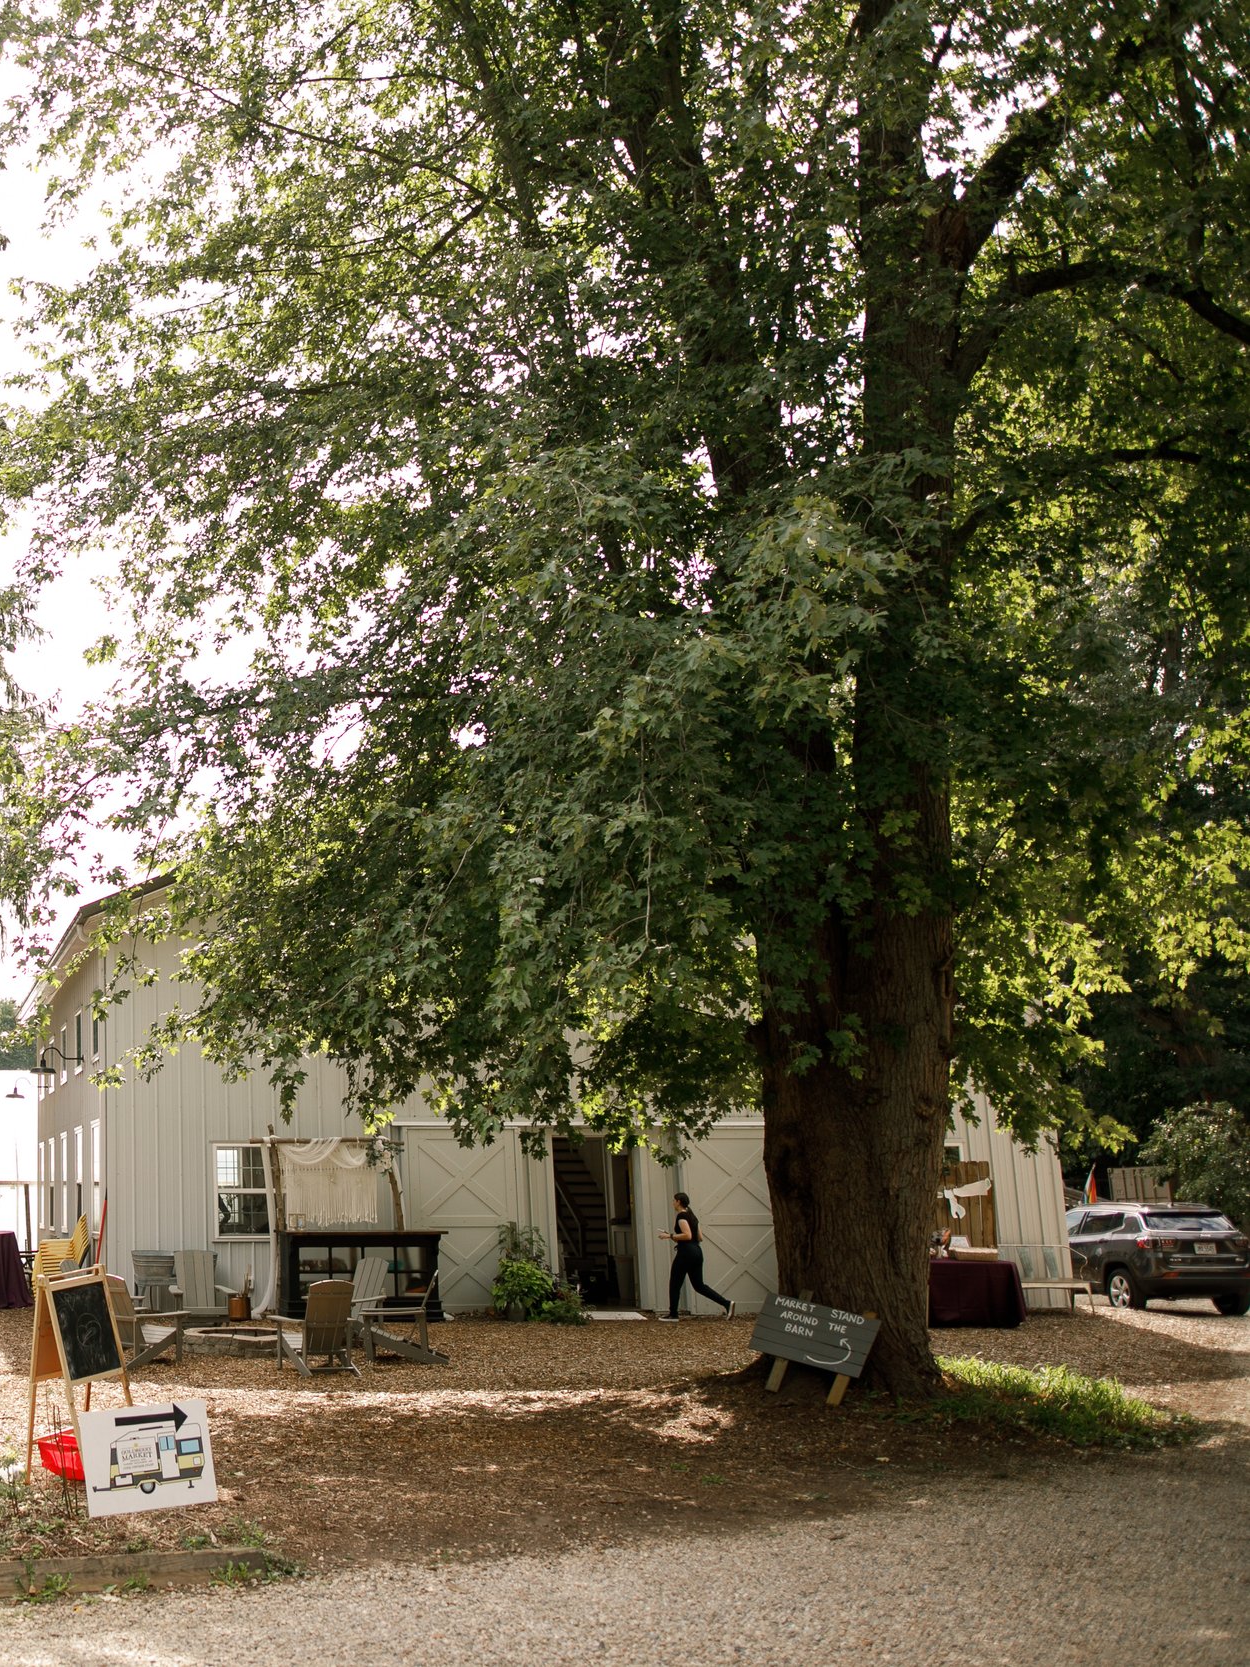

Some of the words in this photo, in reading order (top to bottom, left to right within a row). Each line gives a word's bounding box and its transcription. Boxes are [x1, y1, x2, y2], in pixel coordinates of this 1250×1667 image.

[775, 1296, 817, 1313] MARKET
[830, 1309, 865, 1325] STAND
[780, 1311, 819, 1326] AROUND
[828, 1322, 848, 1334] THE
[784, 1323, 814, 1337] BARN
[122, 1452, 152, 1461] MARKET
